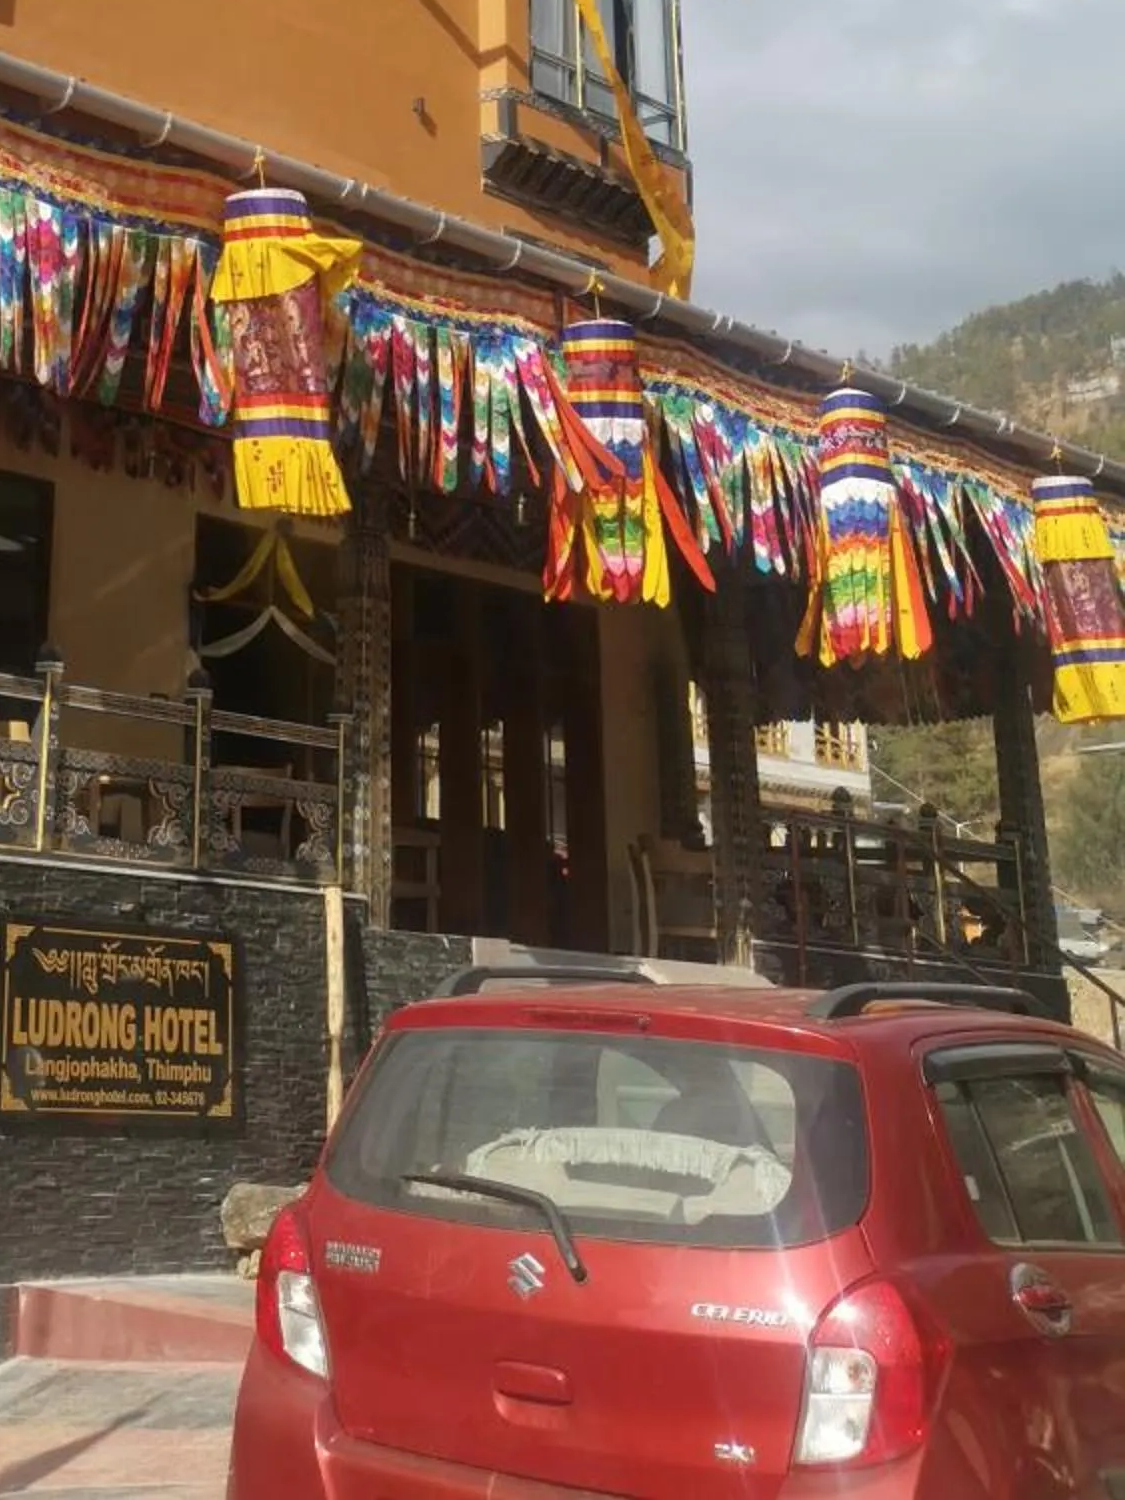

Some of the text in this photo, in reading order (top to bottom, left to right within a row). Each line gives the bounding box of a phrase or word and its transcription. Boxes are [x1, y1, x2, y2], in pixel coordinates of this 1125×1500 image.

[12, 997, 223, 1055] LUDRONG HOTEL
[25, 1053, 212, 1086] Langjophakha, Thimphu
